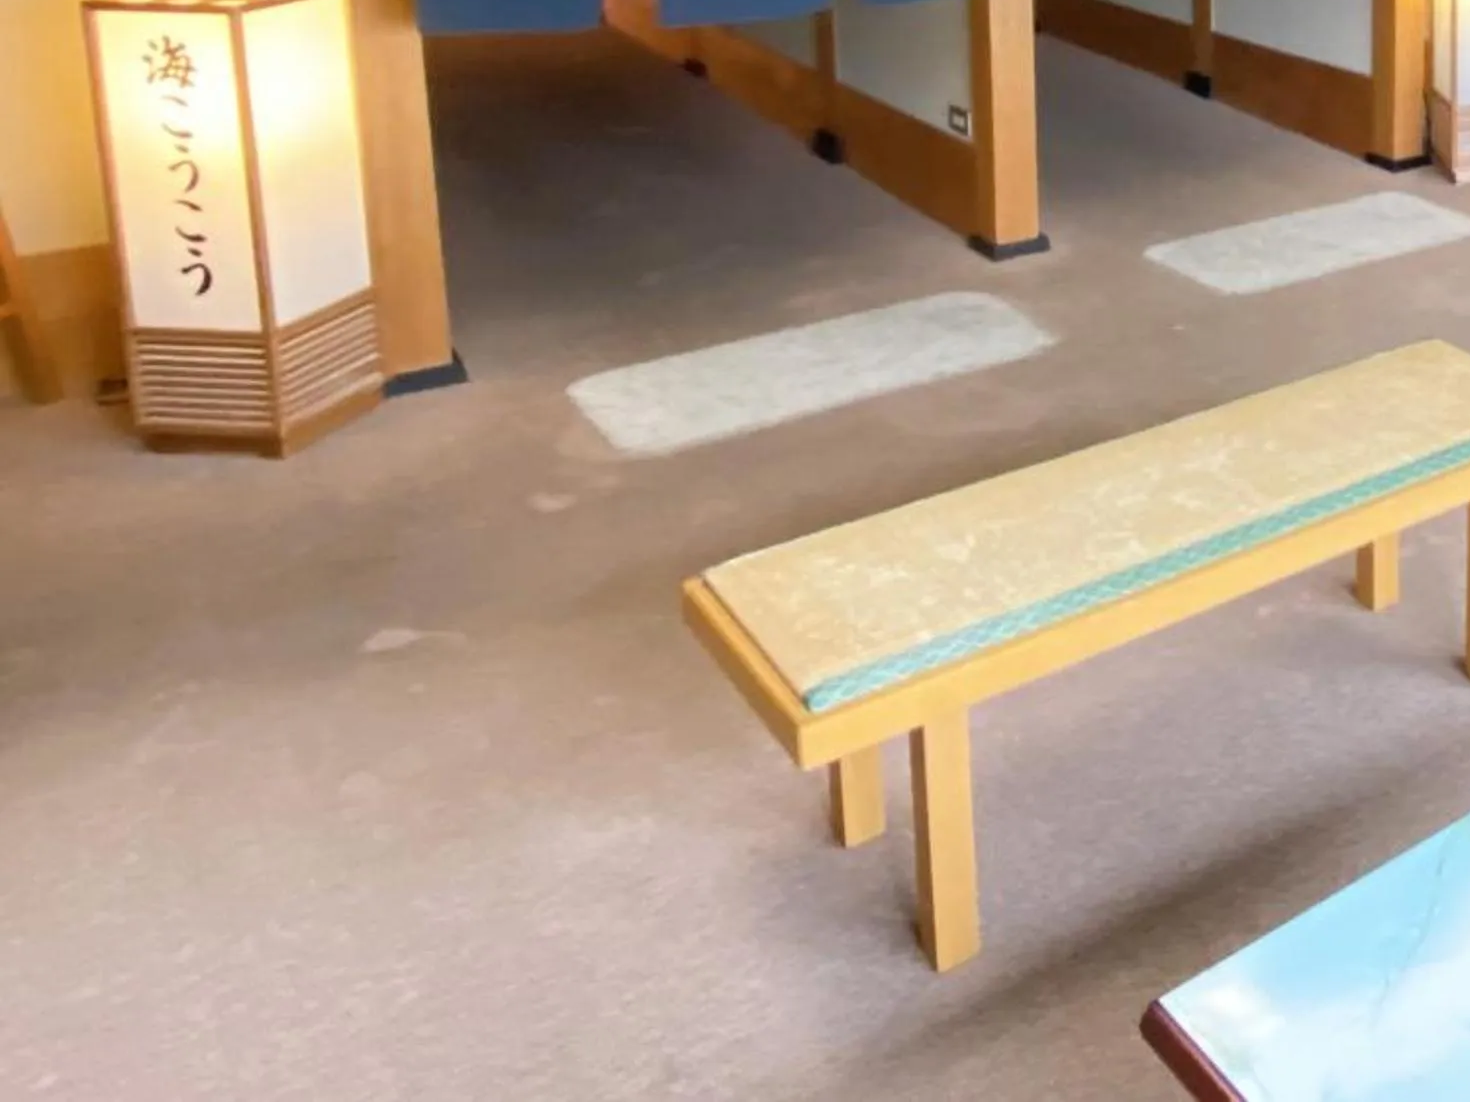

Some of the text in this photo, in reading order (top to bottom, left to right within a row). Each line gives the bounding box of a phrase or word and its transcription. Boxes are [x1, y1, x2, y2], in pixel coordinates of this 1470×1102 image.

[142, 34, 213, 297] 海こうこう
